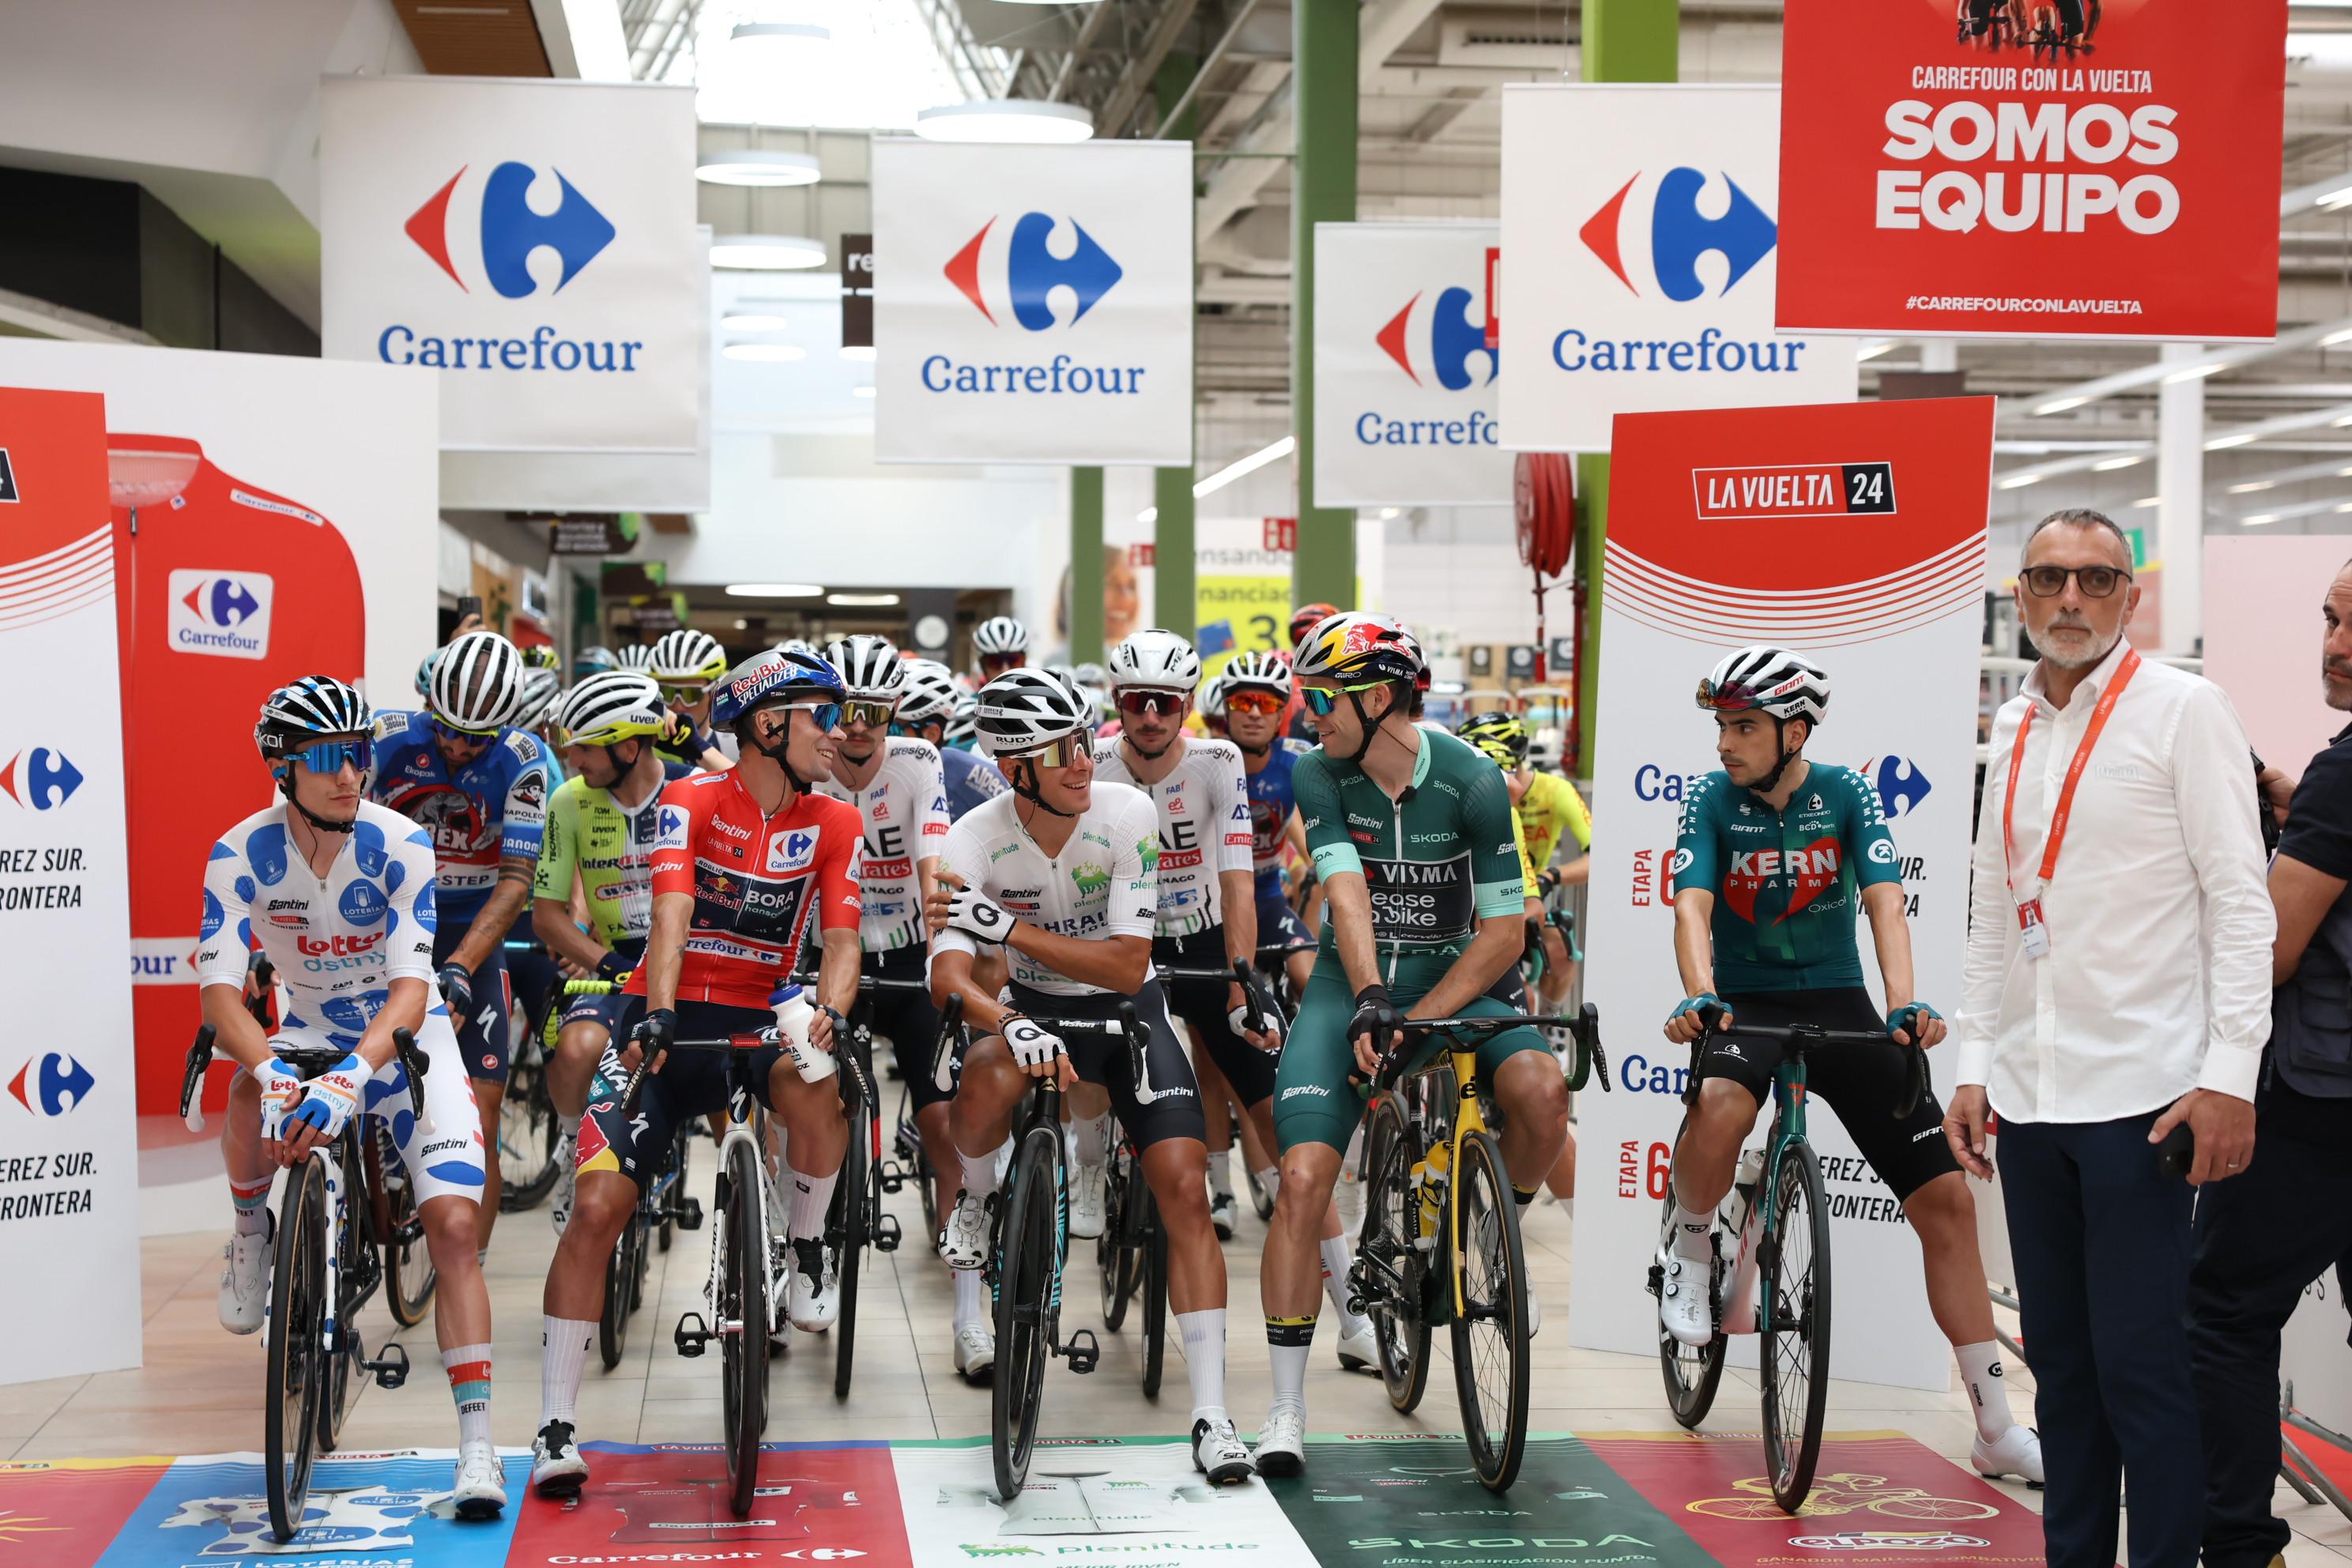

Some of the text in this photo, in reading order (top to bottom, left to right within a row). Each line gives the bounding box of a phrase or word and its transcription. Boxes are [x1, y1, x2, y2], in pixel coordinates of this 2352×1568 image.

[1912, 66, 2152, 94] CARREFOUR CON LA VUELTA
[1882, 100, 2180, 165] SOMOS
[1875, 170, 2180, 235] EQUIPO
[1905, 296, 2143, 315] #CARREFOURCONLAVUELTA
[379, 325, 643, 372] Carrefour
[1552, 328, 1805, 372] Carrefour
[922, 355, 1145, 394] Carrefour
[1708, 473, 1883, 509] LA VUELTA 24
[179, 628, 259, 650] Carrefour
[1123, 643, 1133, 669] MET
[1170, 646, 1183, 673] MET
[1387, 665, 1404, 677] VISMA
[731, 669, 760, 697] Red
[1774, 675, 1804, 695] GIANT
[716, 692, 729, 703] BORA
[1784, 699, 1805, 714] KERN
[631, 714, 656, 725] uvex
[996, 735, 1035, 744] RUDY
[891, 745, 937, 763] presight
[1188, 745, 1235, 763] presight
[711, 813, 752, 840] Santini
[1347, 813, 1384, 830] Santini
[1730, 824, 1766, 833] GIANT
[1083, 831, 1110, 849] plenitude
[43, 848, 87, 872] SUR.
[734, 847, 742, 856] 24
[991, 842, 1020, 864] plenitude
[771, 858, 808, 869] Carrefour
[1730, 848, 1838, 876] KERN
[1382, 864, 1457, 884] VISMA
[1632, 850, 1652, 906] ETAPA
[1730, 876, 1839, 890] PHARMA
[717, 891, 742, 910] Bull
[746, 891, 793, 907] BORA
[1000, 888, 1042, 899] Santini
[267, 899, 309, 910] Santini
[1808, 895, 1847, 913] Oxicol
[1059, 1019, 1095, 1029] Vision
[1280, 1084, 1331, 1102] Santini
[420, 1139, 468, 1158] Santini
[54, 1152, 97, 1178] SUR.
[1619, 1140, 1639, 1199] ETAPA
[1056, 1540, 1261, 1555] plenitude
[548, 1552, 762, 1565] Carrefour
[1382, 1556, 1434, 1566] LÍDER
[1583, 1554, 1657, 1566] PUNTOS
